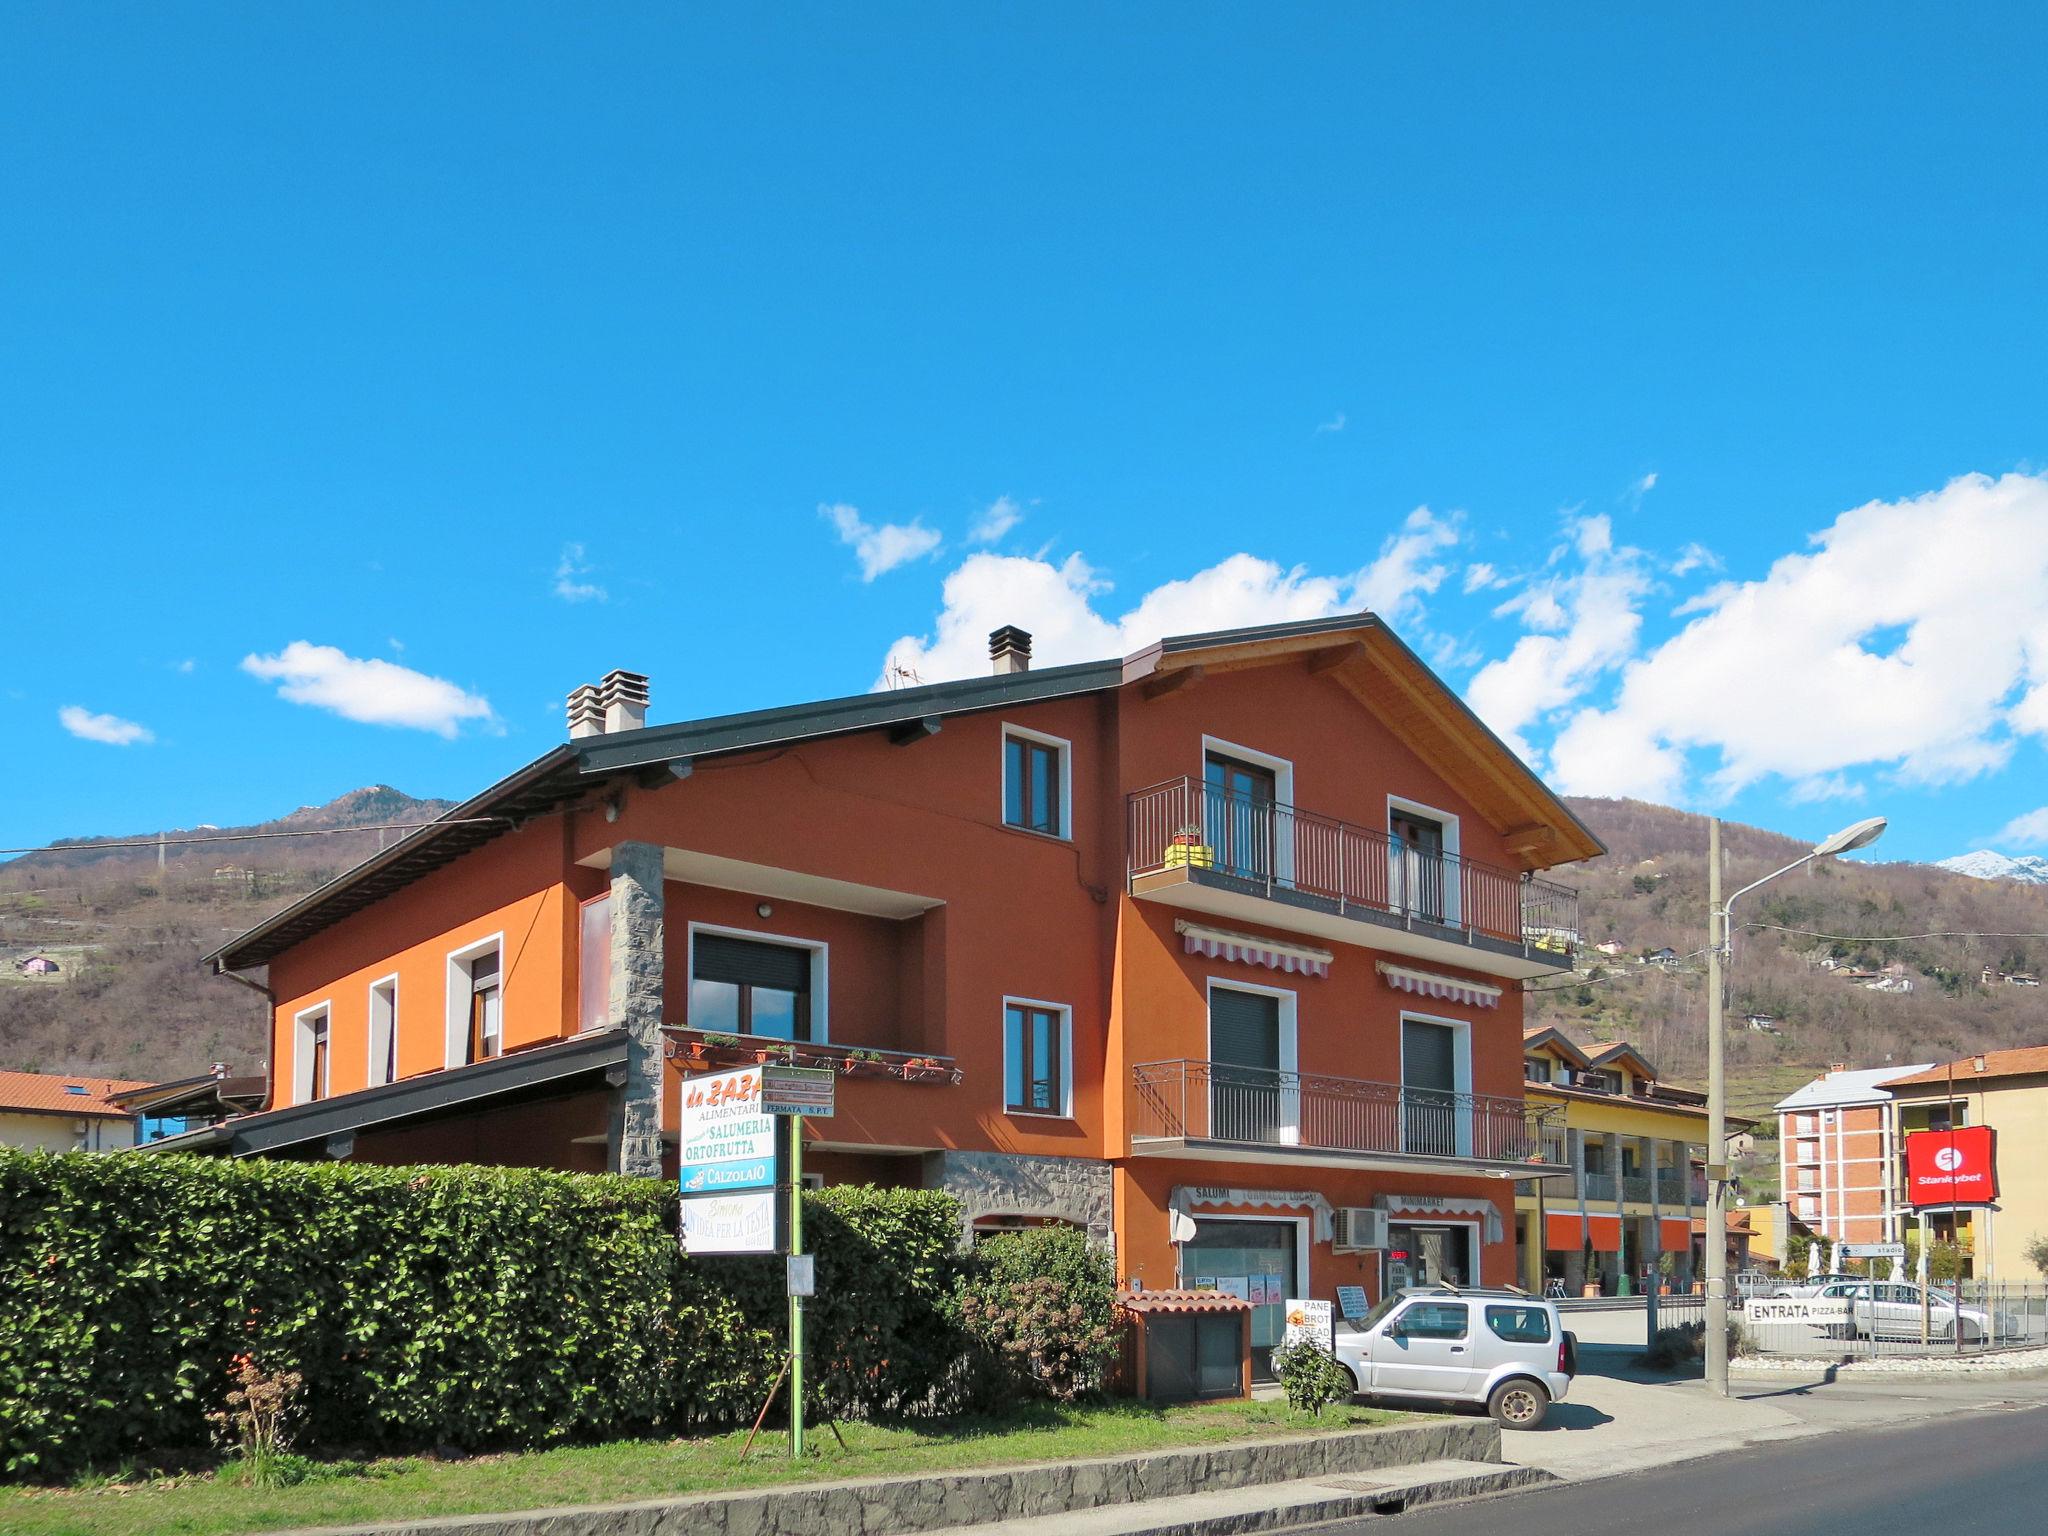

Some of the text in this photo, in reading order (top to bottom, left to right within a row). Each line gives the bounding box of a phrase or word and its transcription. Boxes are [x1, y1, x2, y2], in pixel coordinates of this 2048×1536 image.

[686, 1085, 703, 1108] da
[699, 1103, 760, 1121] ALIMENTARI
[767, 1105, 801, 1113] FERMATA
[709, 1118, 771, 1140] SALUMERIA
[686, 1140, 754, 1160] ORTOFRUTTA
[707, 1164, 766, 1184] CALZOLAIO
[1918, 1173, 1982, 1184] Stanleybet
[1196, 1187, 1230, 1199] SALUMI
[1401, 1196, 1444, 1207] MINIMARKET
[1304, 1302, 1329, 1311] PANE
[1754, 1305, 1809, 1318] ENTRATA
[1304, 1314, 1330, 1323] BROT
[1298, 1327, 1330, 1337] BREAD
